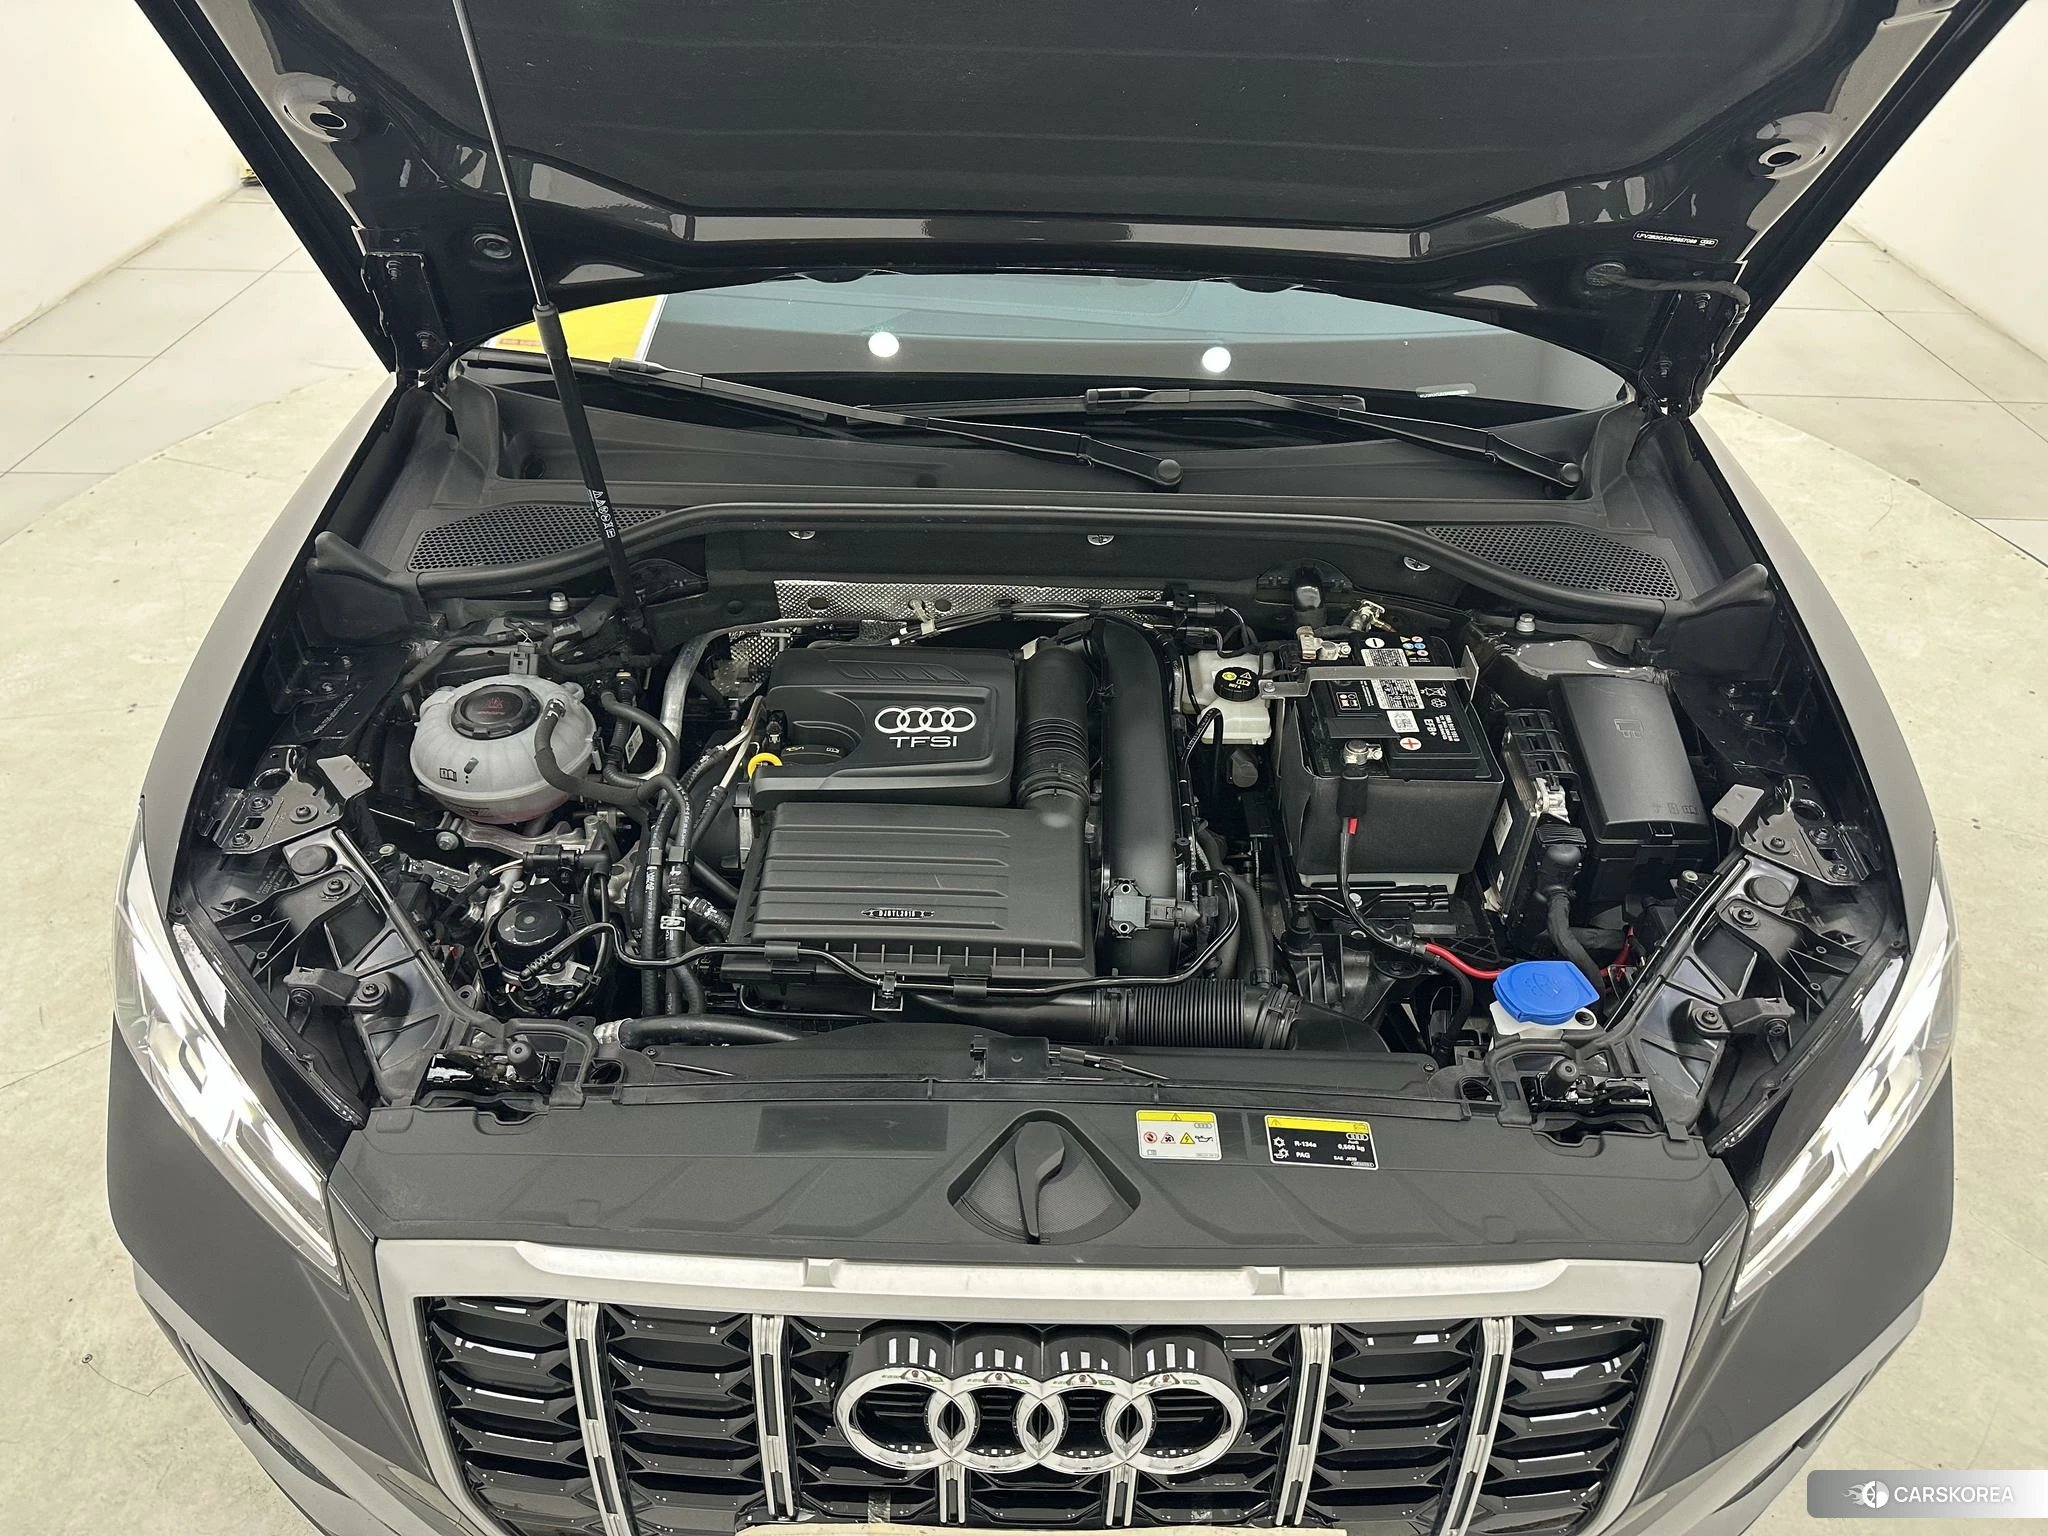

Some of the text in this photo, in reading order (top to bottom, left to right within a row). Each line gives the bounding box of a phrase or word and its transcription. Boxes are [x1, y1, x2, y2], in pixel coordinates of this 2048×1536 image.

[1423, 718, 1437, 736] EFB+
[889, 735, 958, 748] TFSI
[1294, 1140, 1317, 1148] R-134a
